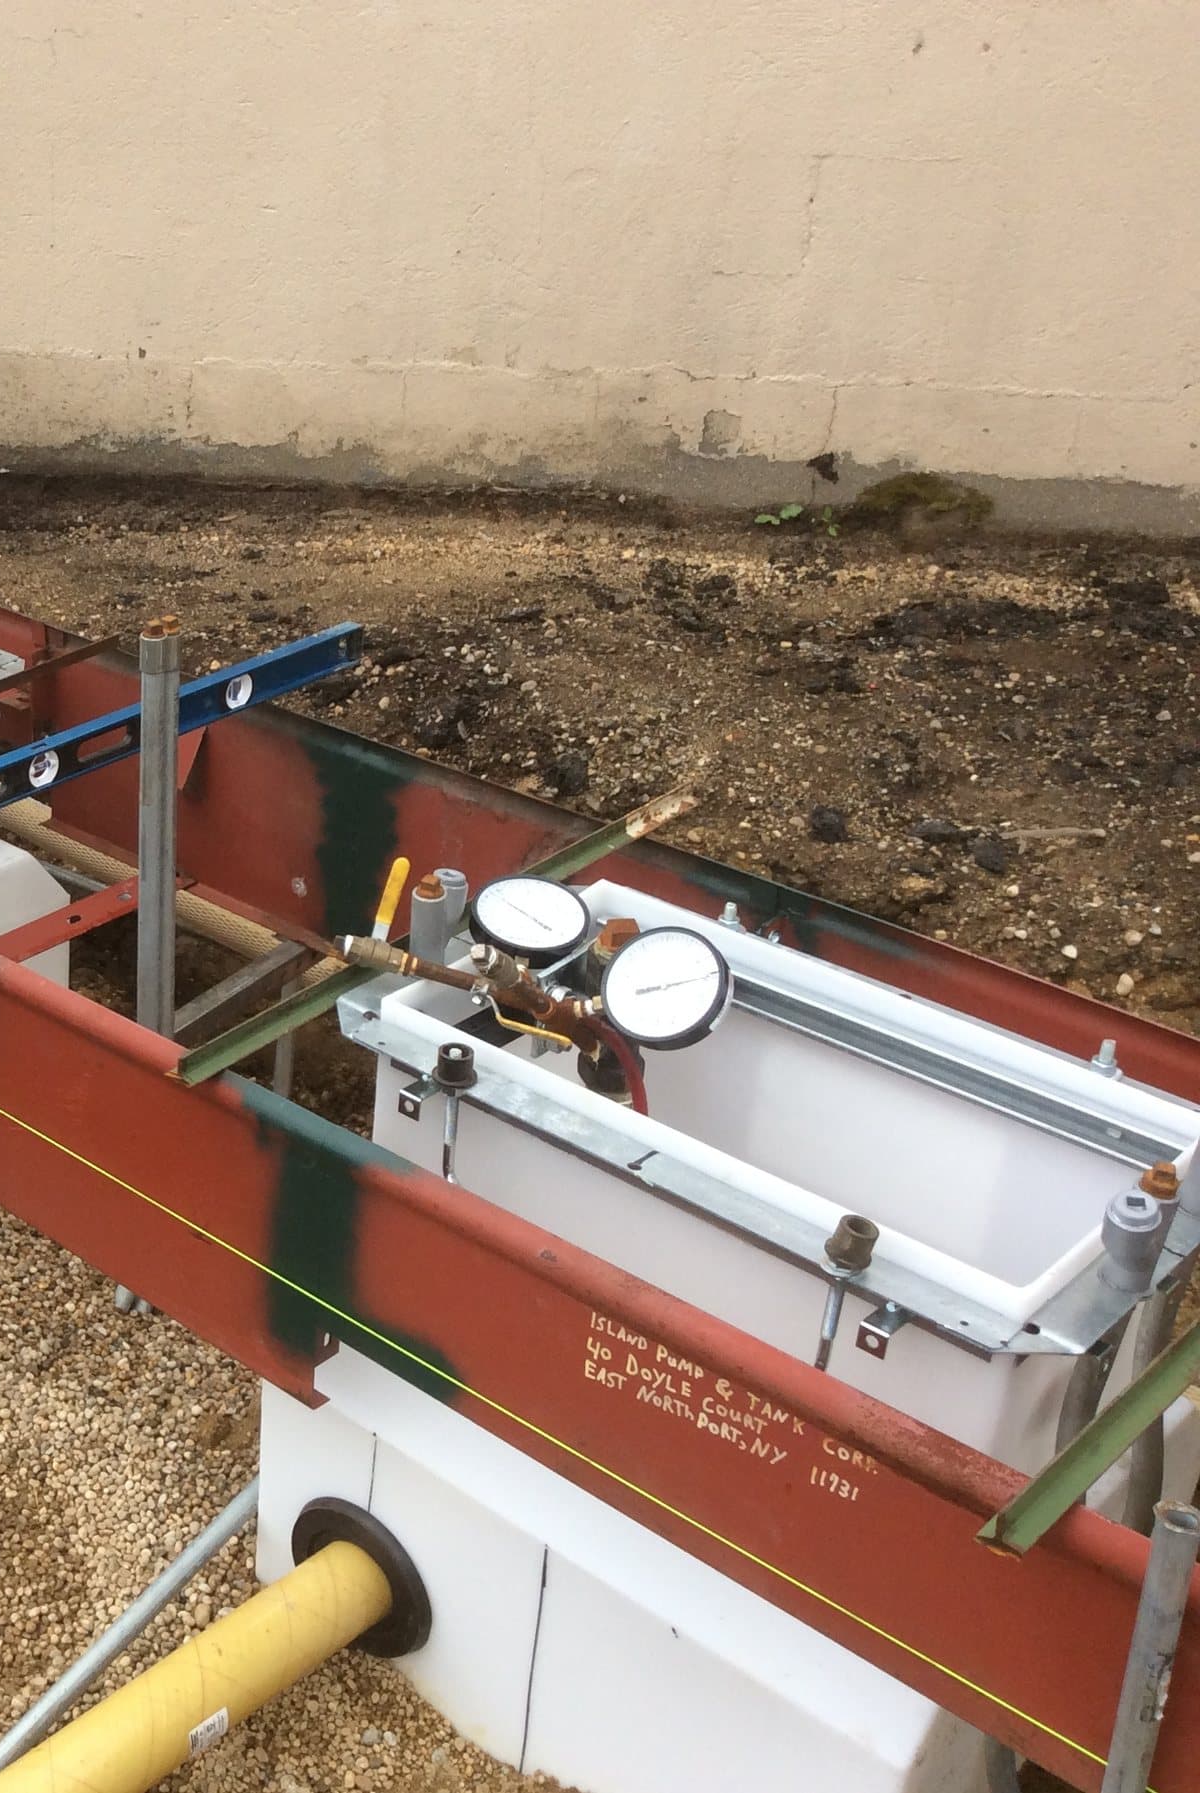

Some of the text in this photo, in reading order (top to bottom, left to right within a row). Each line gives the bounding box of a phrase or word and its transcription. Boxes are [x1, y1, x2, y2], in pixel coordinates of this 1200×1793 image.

[584, 1360, 627, 1389] EAST
[810, 1466, 860, 1501] 11931
[587, 1337, 768, 1434] 40 DOYLE COURT
[591, 1312, 648, 1350] ISLAND
[656, 1344, 705, 1380] PUMP
[715, 1379, 734, 1401] &
[746, 1391, 804, 1436] TANK
